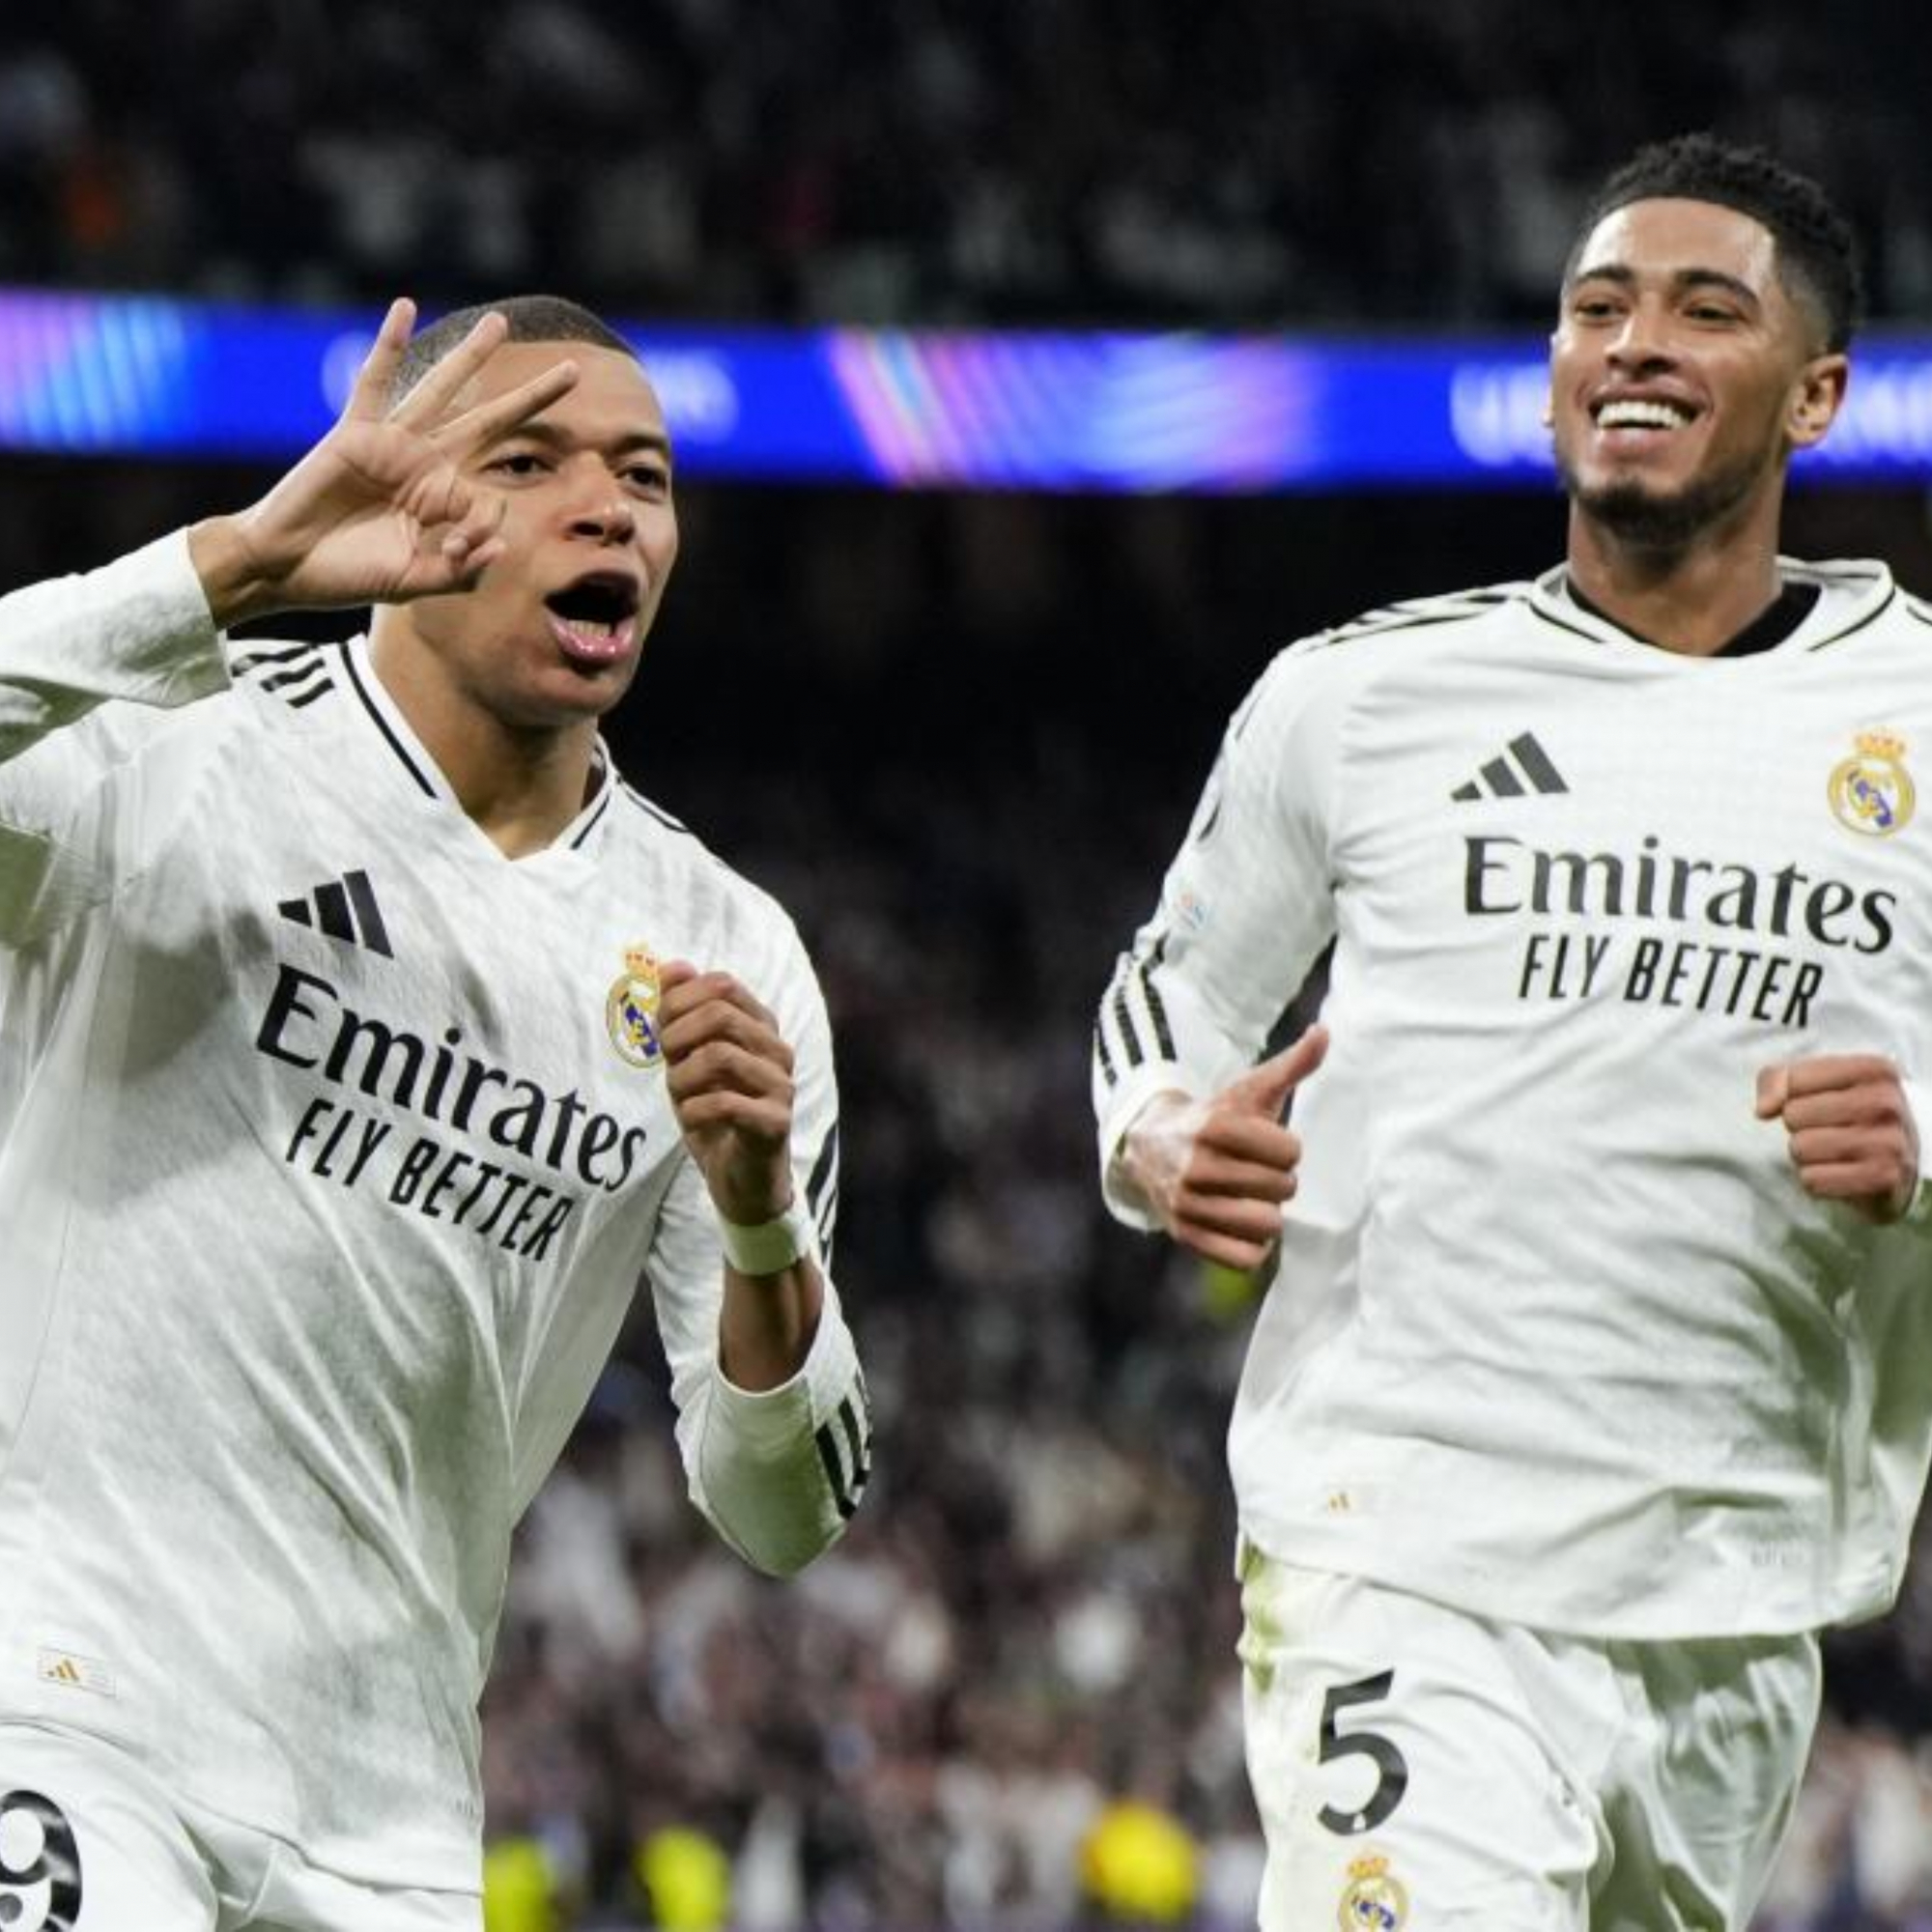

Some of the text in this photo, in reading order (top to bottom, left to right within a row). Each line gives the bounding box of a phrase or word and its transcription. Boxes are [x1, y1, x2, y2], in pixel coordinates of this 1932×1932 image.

[1463, 836, 1898, 955] Emirates
[1518, 934, 1824, 1031] FLY BETTER
[255, 962, 647, 1194] Emirates
[285, 1097, 578, 1263] FLY BETTER
[1317, 1668, 1408, 1835] 5
[0, 1788, 83, 1932] 9
